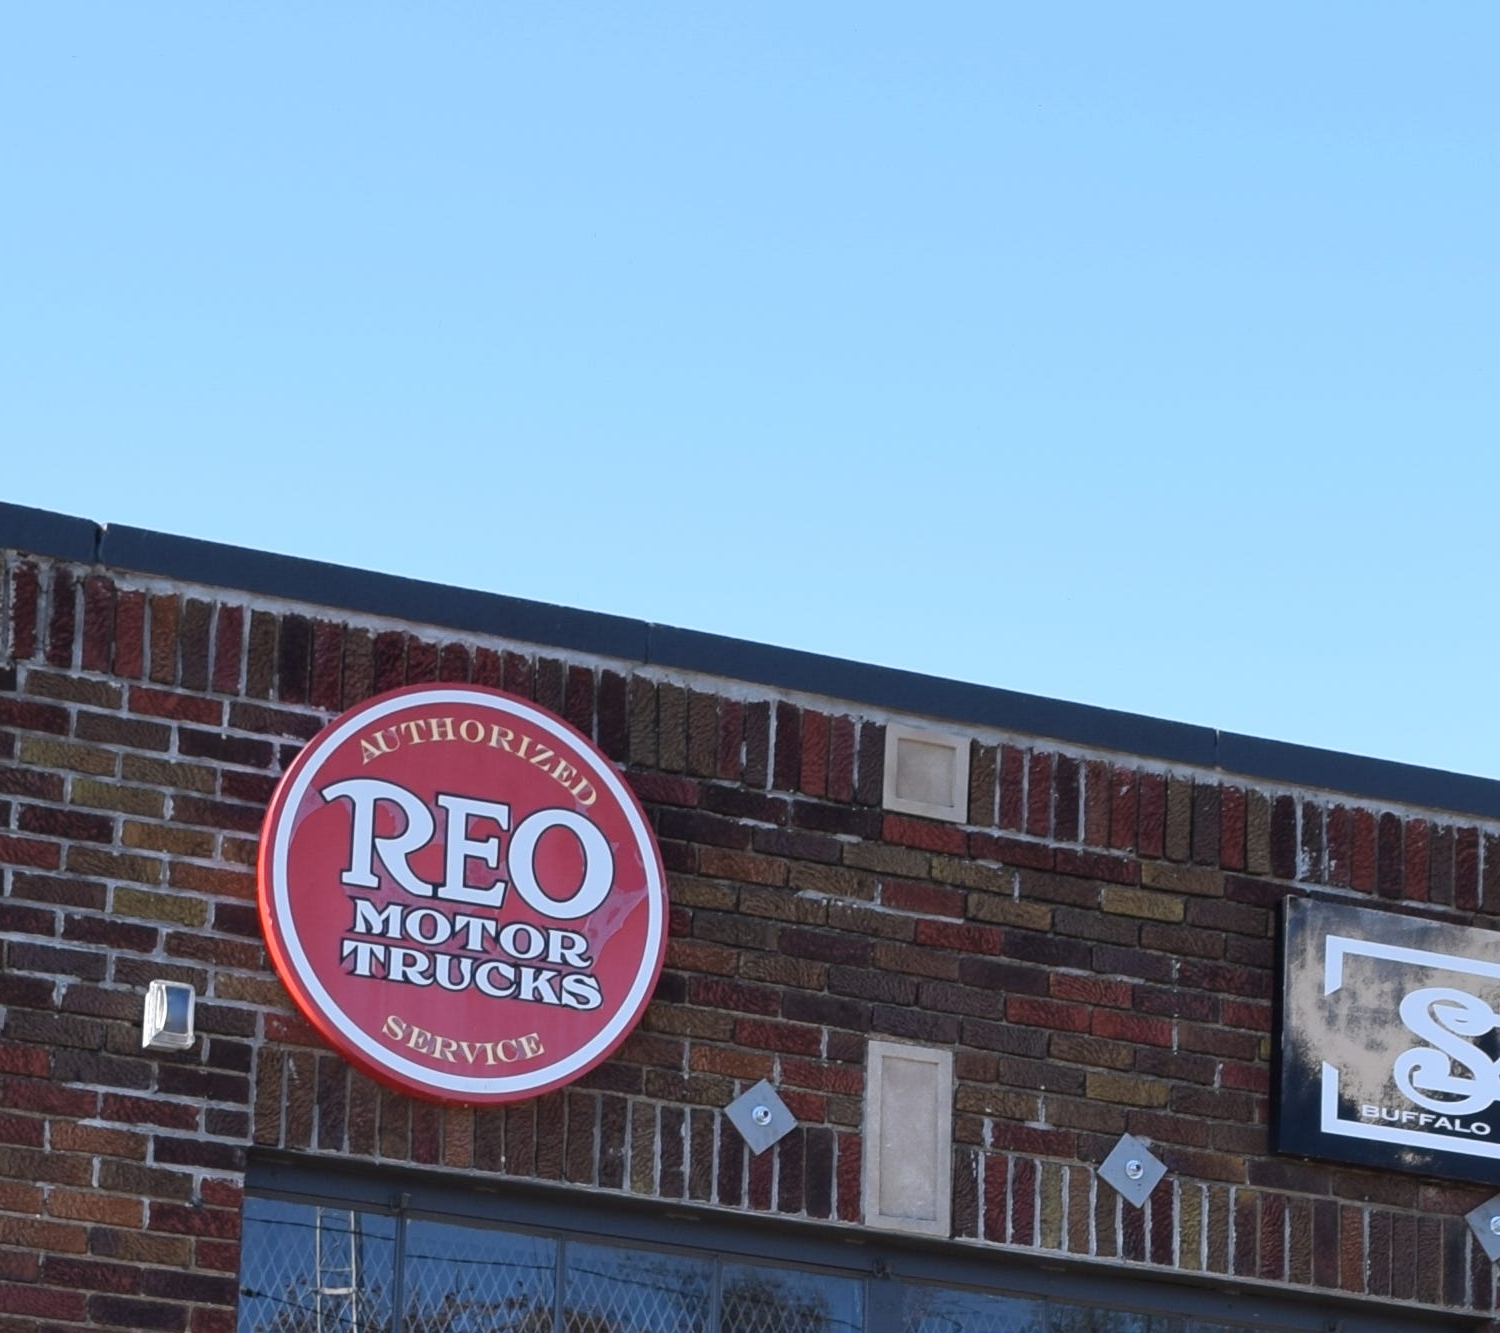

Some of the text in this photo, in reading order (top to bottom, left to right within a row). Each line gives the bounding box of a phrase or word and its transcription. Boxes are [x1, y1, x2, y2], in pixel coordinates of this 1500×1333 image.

[360, 717, 597, 806] AUTHORIZED
[319, 777, 617, 921] REO
[352, 898, 593, 968] MOTOR
[339, 938, 604, 1012] TRUCKS
[380, 1014, 547, 1066] SERVICE
[1361, 1103, 1493, 1137] BUFFALO
